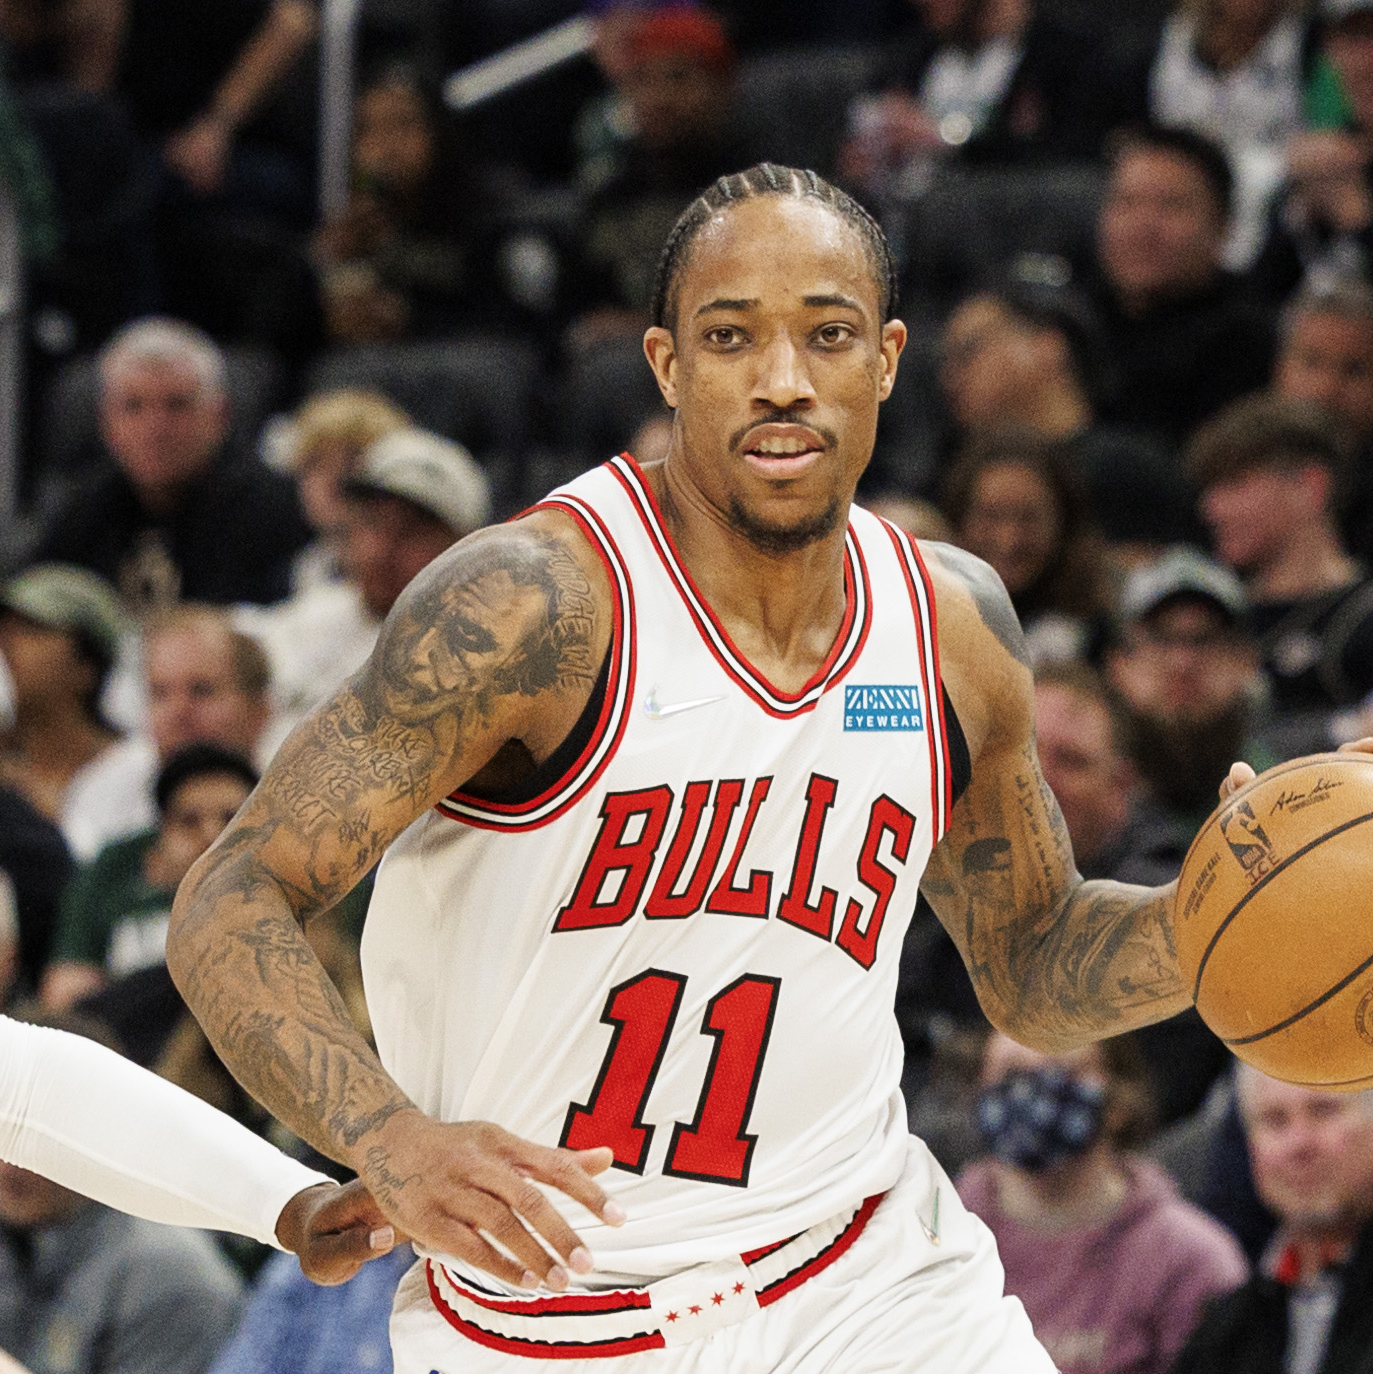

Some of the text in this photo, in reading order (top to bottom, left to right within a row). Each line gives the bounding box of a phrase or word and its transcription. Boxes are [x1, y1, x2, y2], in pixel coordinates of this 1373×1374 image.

[847, 688, 918, 710] ZENNI
[845, 714, 921, 728] EYEWEAR
[551, 772, 917, 971] BULLS
[1245, 851, 1281, 886] ICE
[558, 967, 782, 1188] 11
